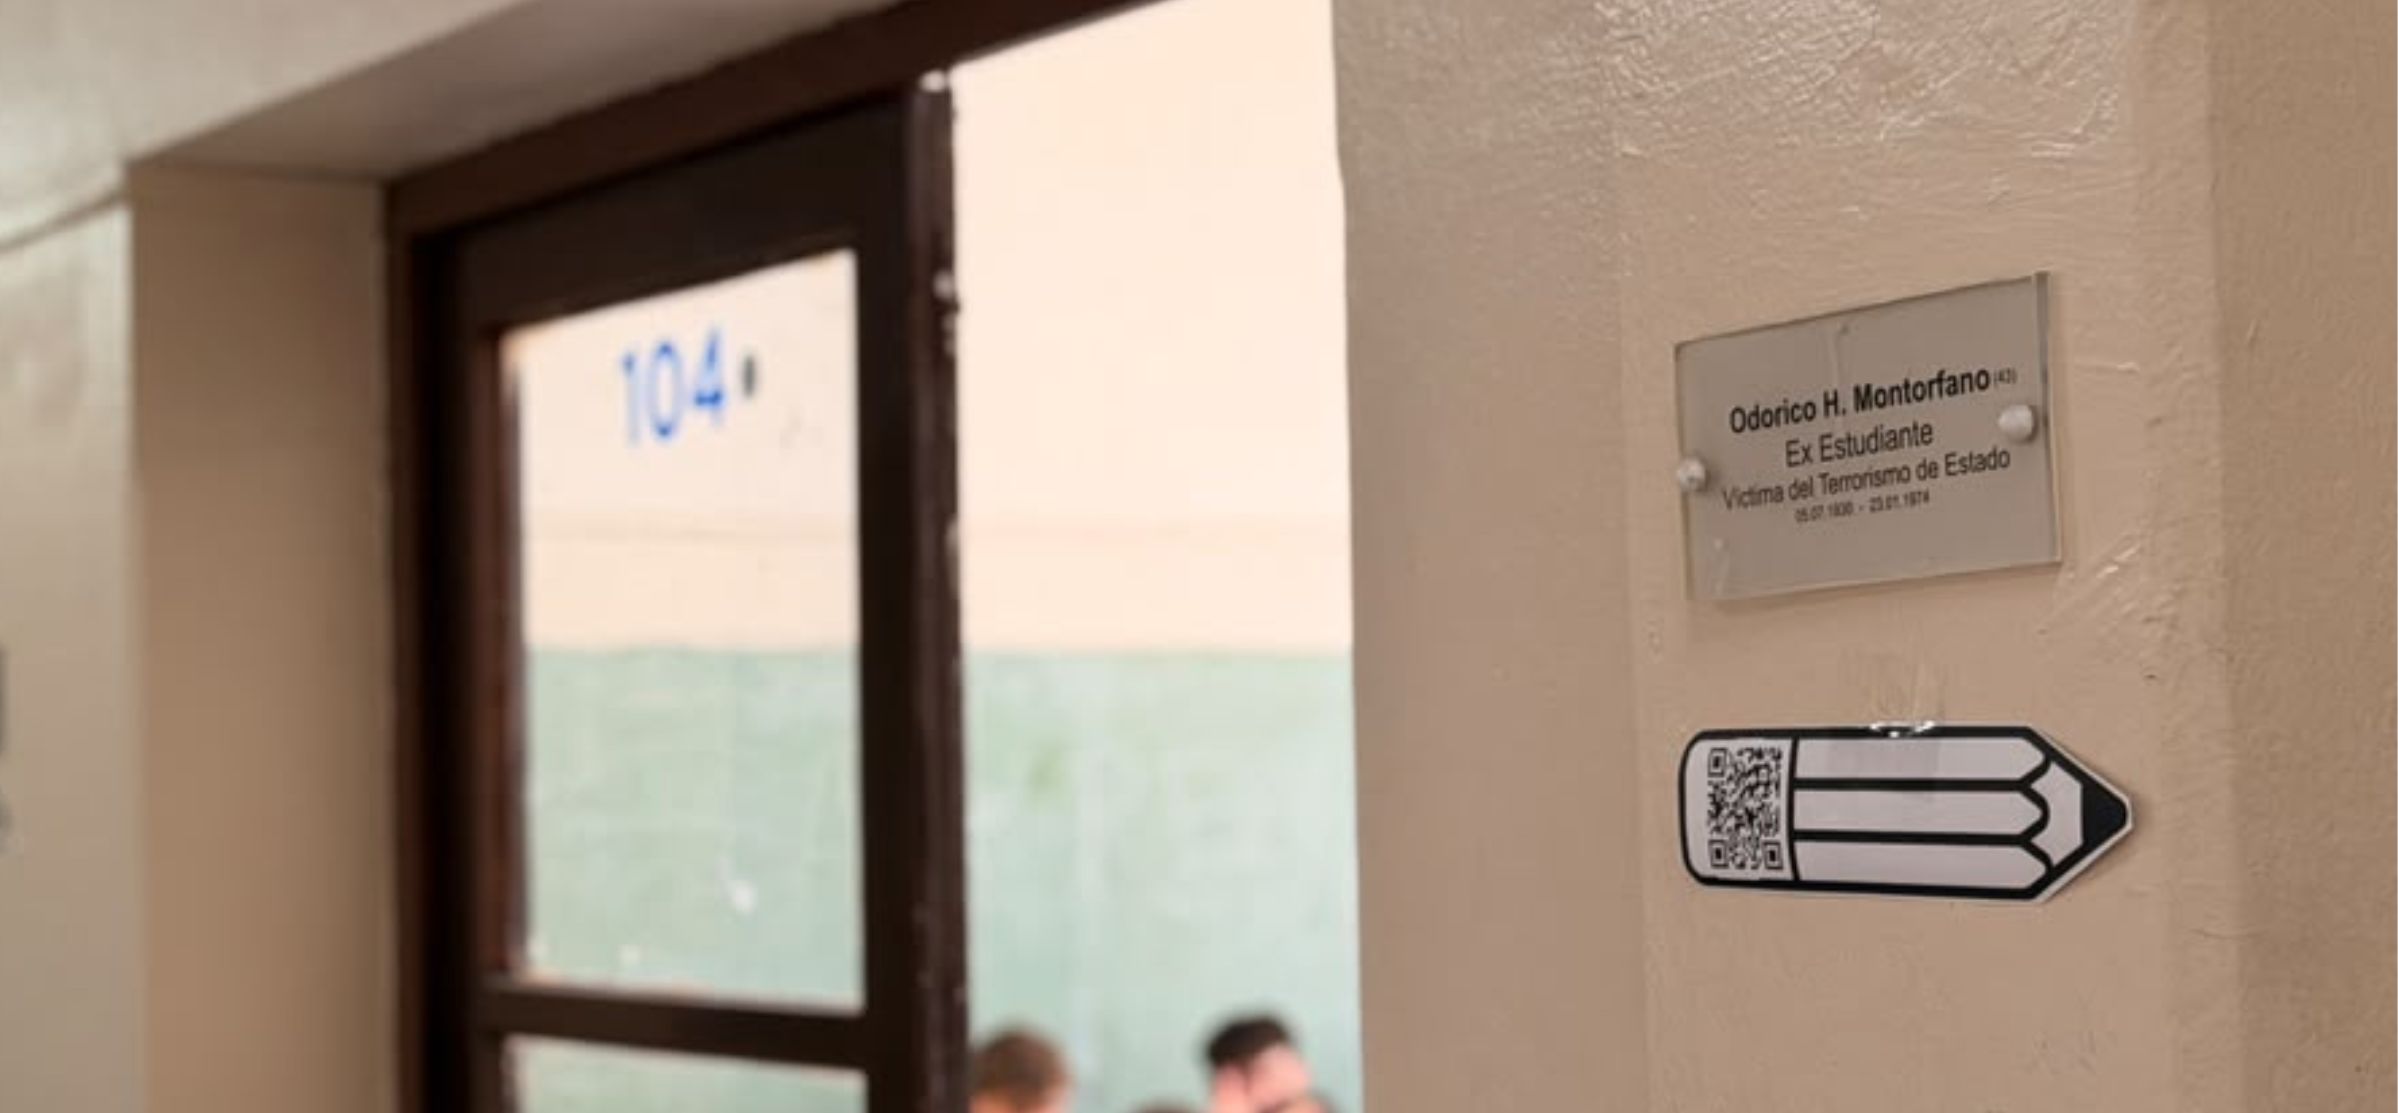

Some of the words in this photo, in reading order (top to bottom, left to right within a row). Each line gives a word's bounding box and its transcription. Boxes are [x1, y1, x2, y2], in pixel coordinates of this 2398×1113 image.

[620, 327, 726, 446] 104
[1730, 399, 1817, 433] Odorico
[1823, 389, 1847, 417] H.
[1853, 368, 1990, 413] Montorfano
[1786, 438, 1813, 468] Ex
[1820, 421, 1934, 463] Estudiante
[1788, 475, 1813, 501] del
[1819, 465, 1911, 496] Terrorismo
[1915, 457, 1939, 482] de
[1944, 446, 2011, 477] Estado
